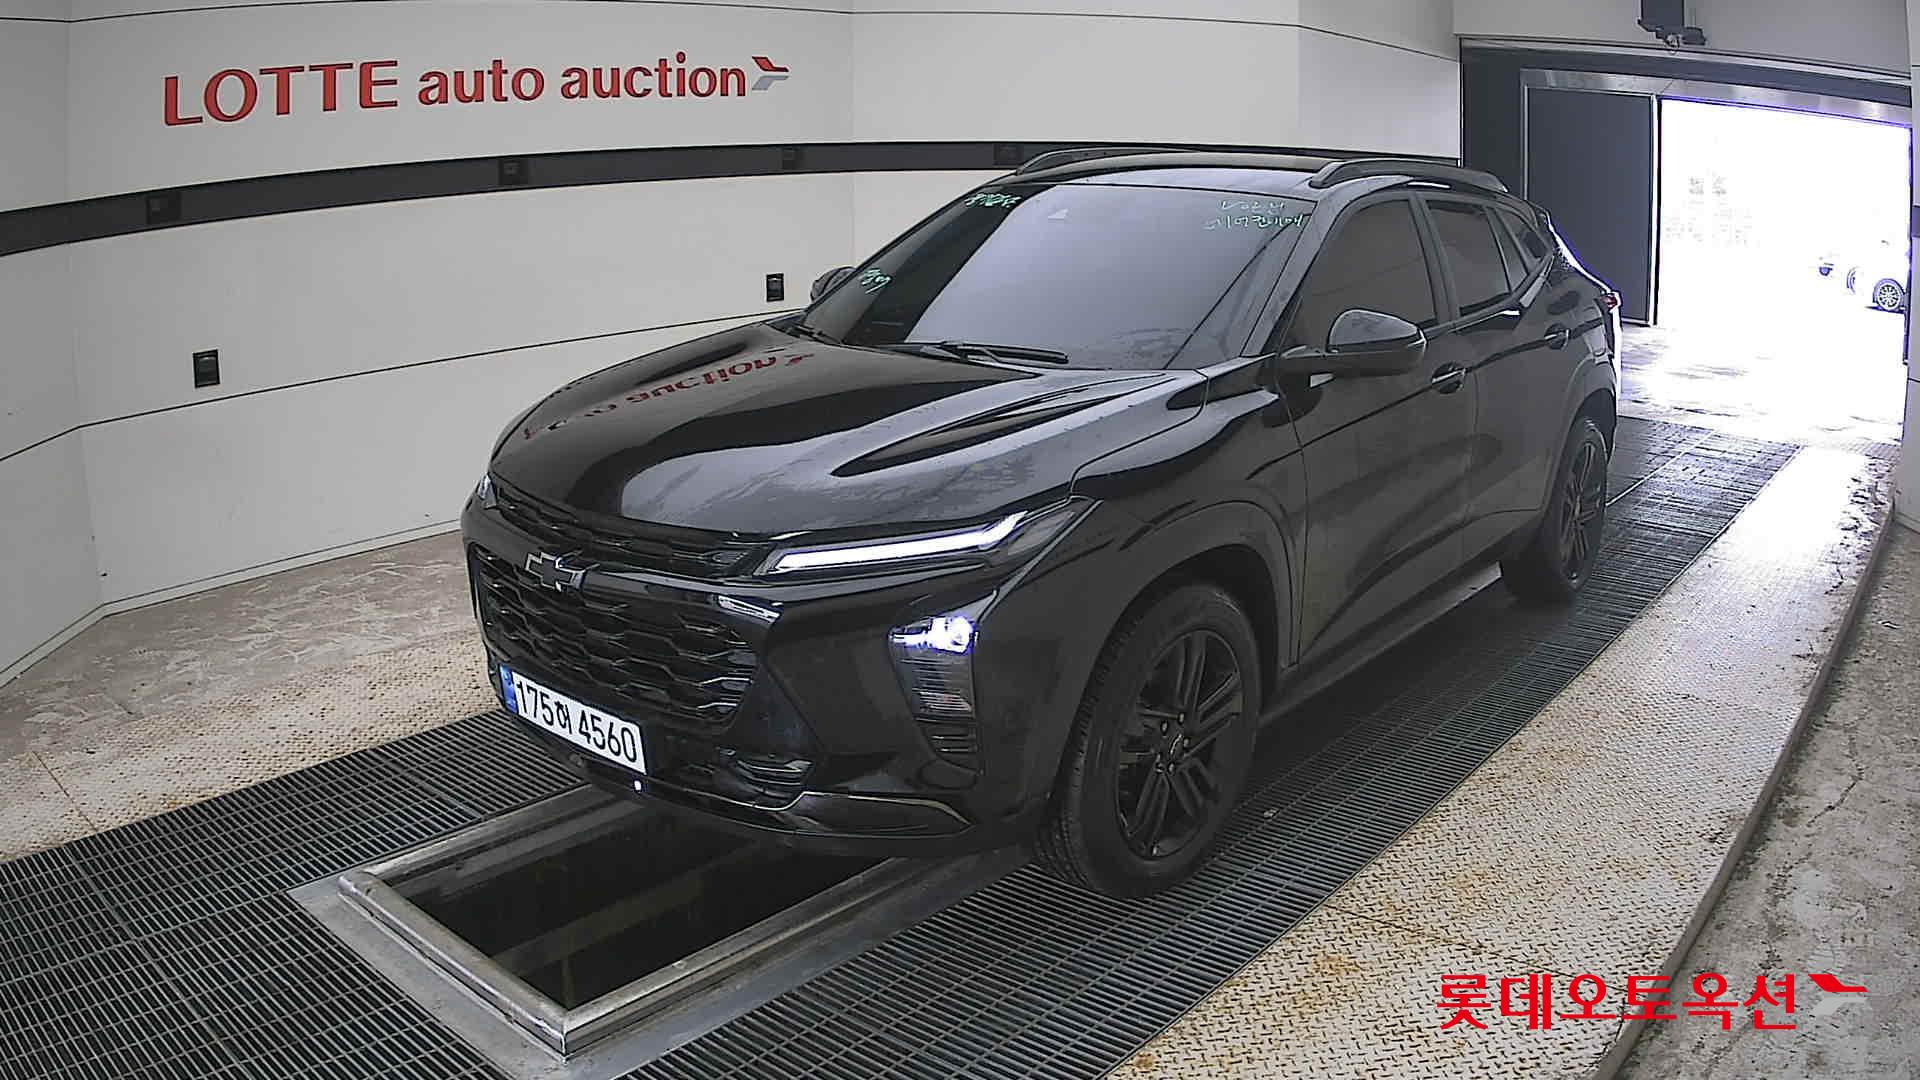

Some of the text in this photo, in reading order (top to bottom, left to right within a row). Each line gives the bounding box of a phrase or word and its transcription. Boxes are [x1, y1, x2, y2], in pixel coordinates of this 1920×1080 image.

[163, 51, 747, 127] LOTTE auto auction
[516, 681, 638, 763] 175허 4560
